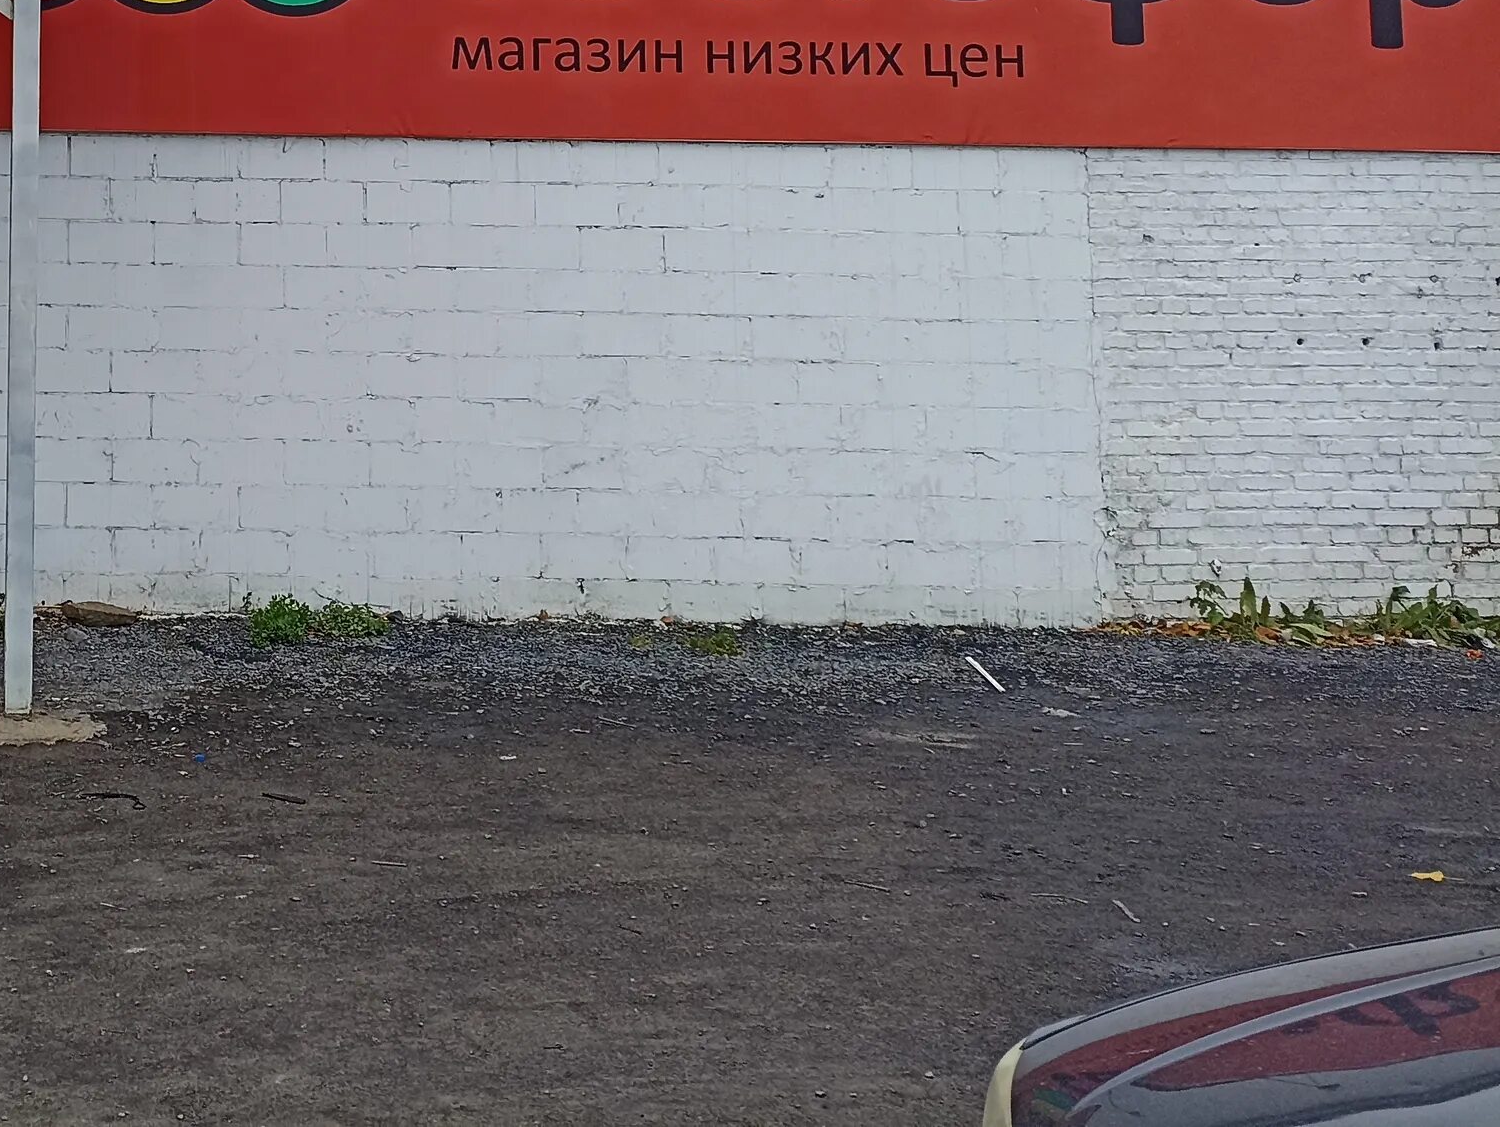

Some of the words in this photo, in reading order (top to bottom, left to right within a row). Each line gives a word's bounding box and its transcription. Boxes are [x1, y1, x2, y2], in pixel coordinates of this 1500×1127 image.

[452, 37, 683, 73] магазин
[706, 40, 904, 75] низких
[924, 42, 1025, 88] цен
